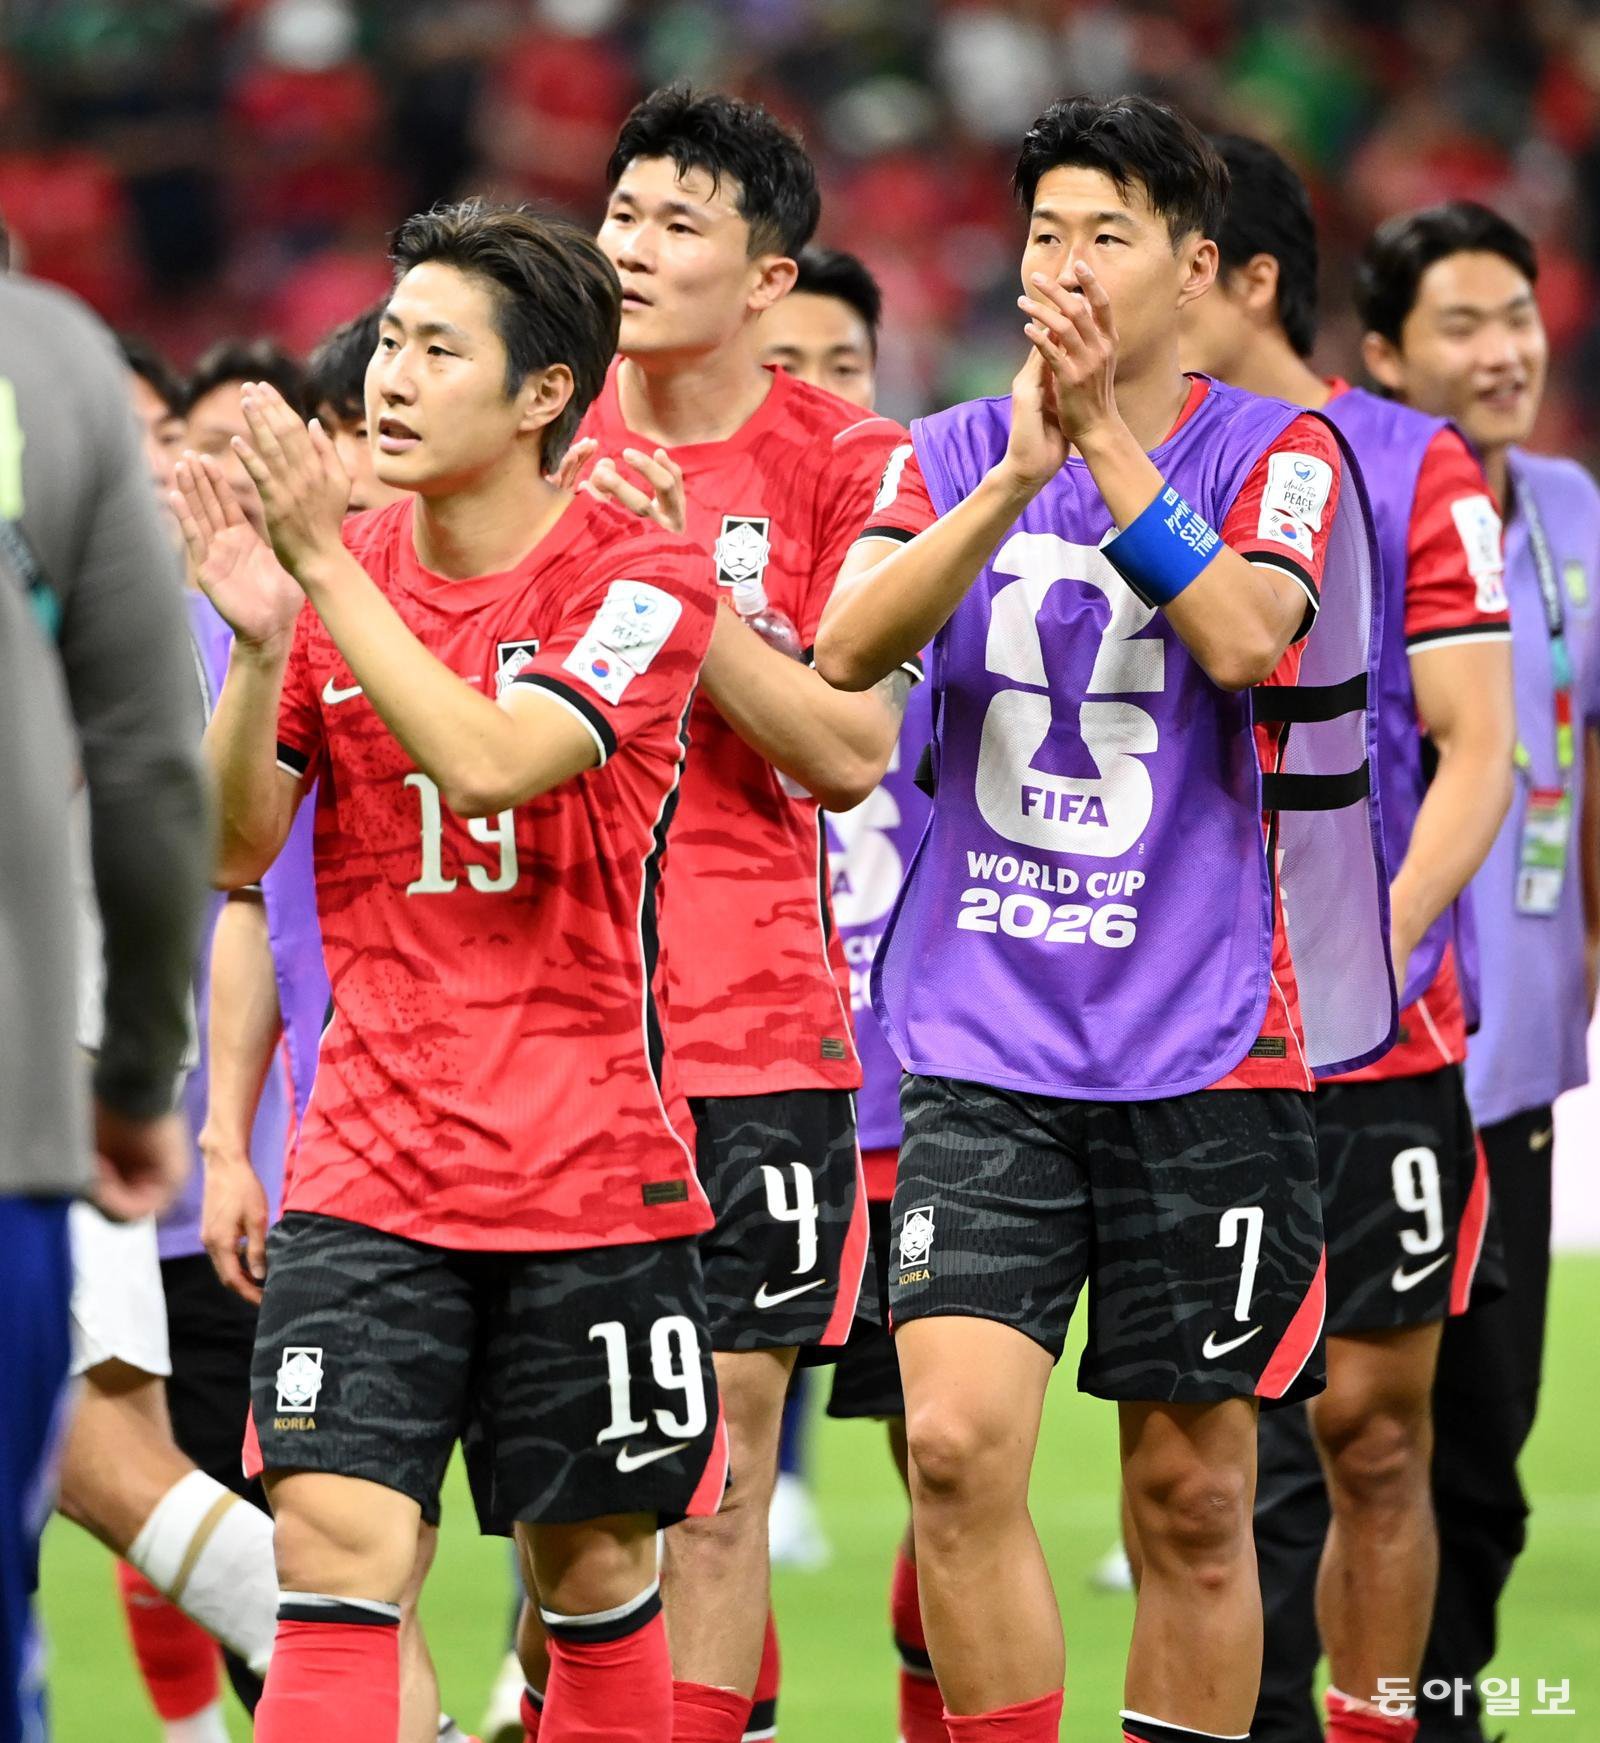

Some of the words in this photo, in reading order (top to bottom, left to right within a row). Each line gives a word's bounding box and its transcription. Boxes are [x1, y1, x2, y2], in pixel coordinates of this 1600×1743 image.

[1283, 491, 1313, 511] PEACE
[404, 773, 519, 898] 19
[1021, 785, 1109, 827] FIFA
[966, 850, 1080, 895] WORLD
[1086, 870, 1146, 899] CUP
[957, 887, 1139, 948] 2026
[760, 1162, 819, 1274] 4
[1391, 1147, 1443, 1255] 9
[898, 1268, 931, 1286] KOREA
[1215, 1207, 1264, 1321] 7
[588, 1315, 707, 1446] 19
[273, 1416, 317, 1431] KOREA
